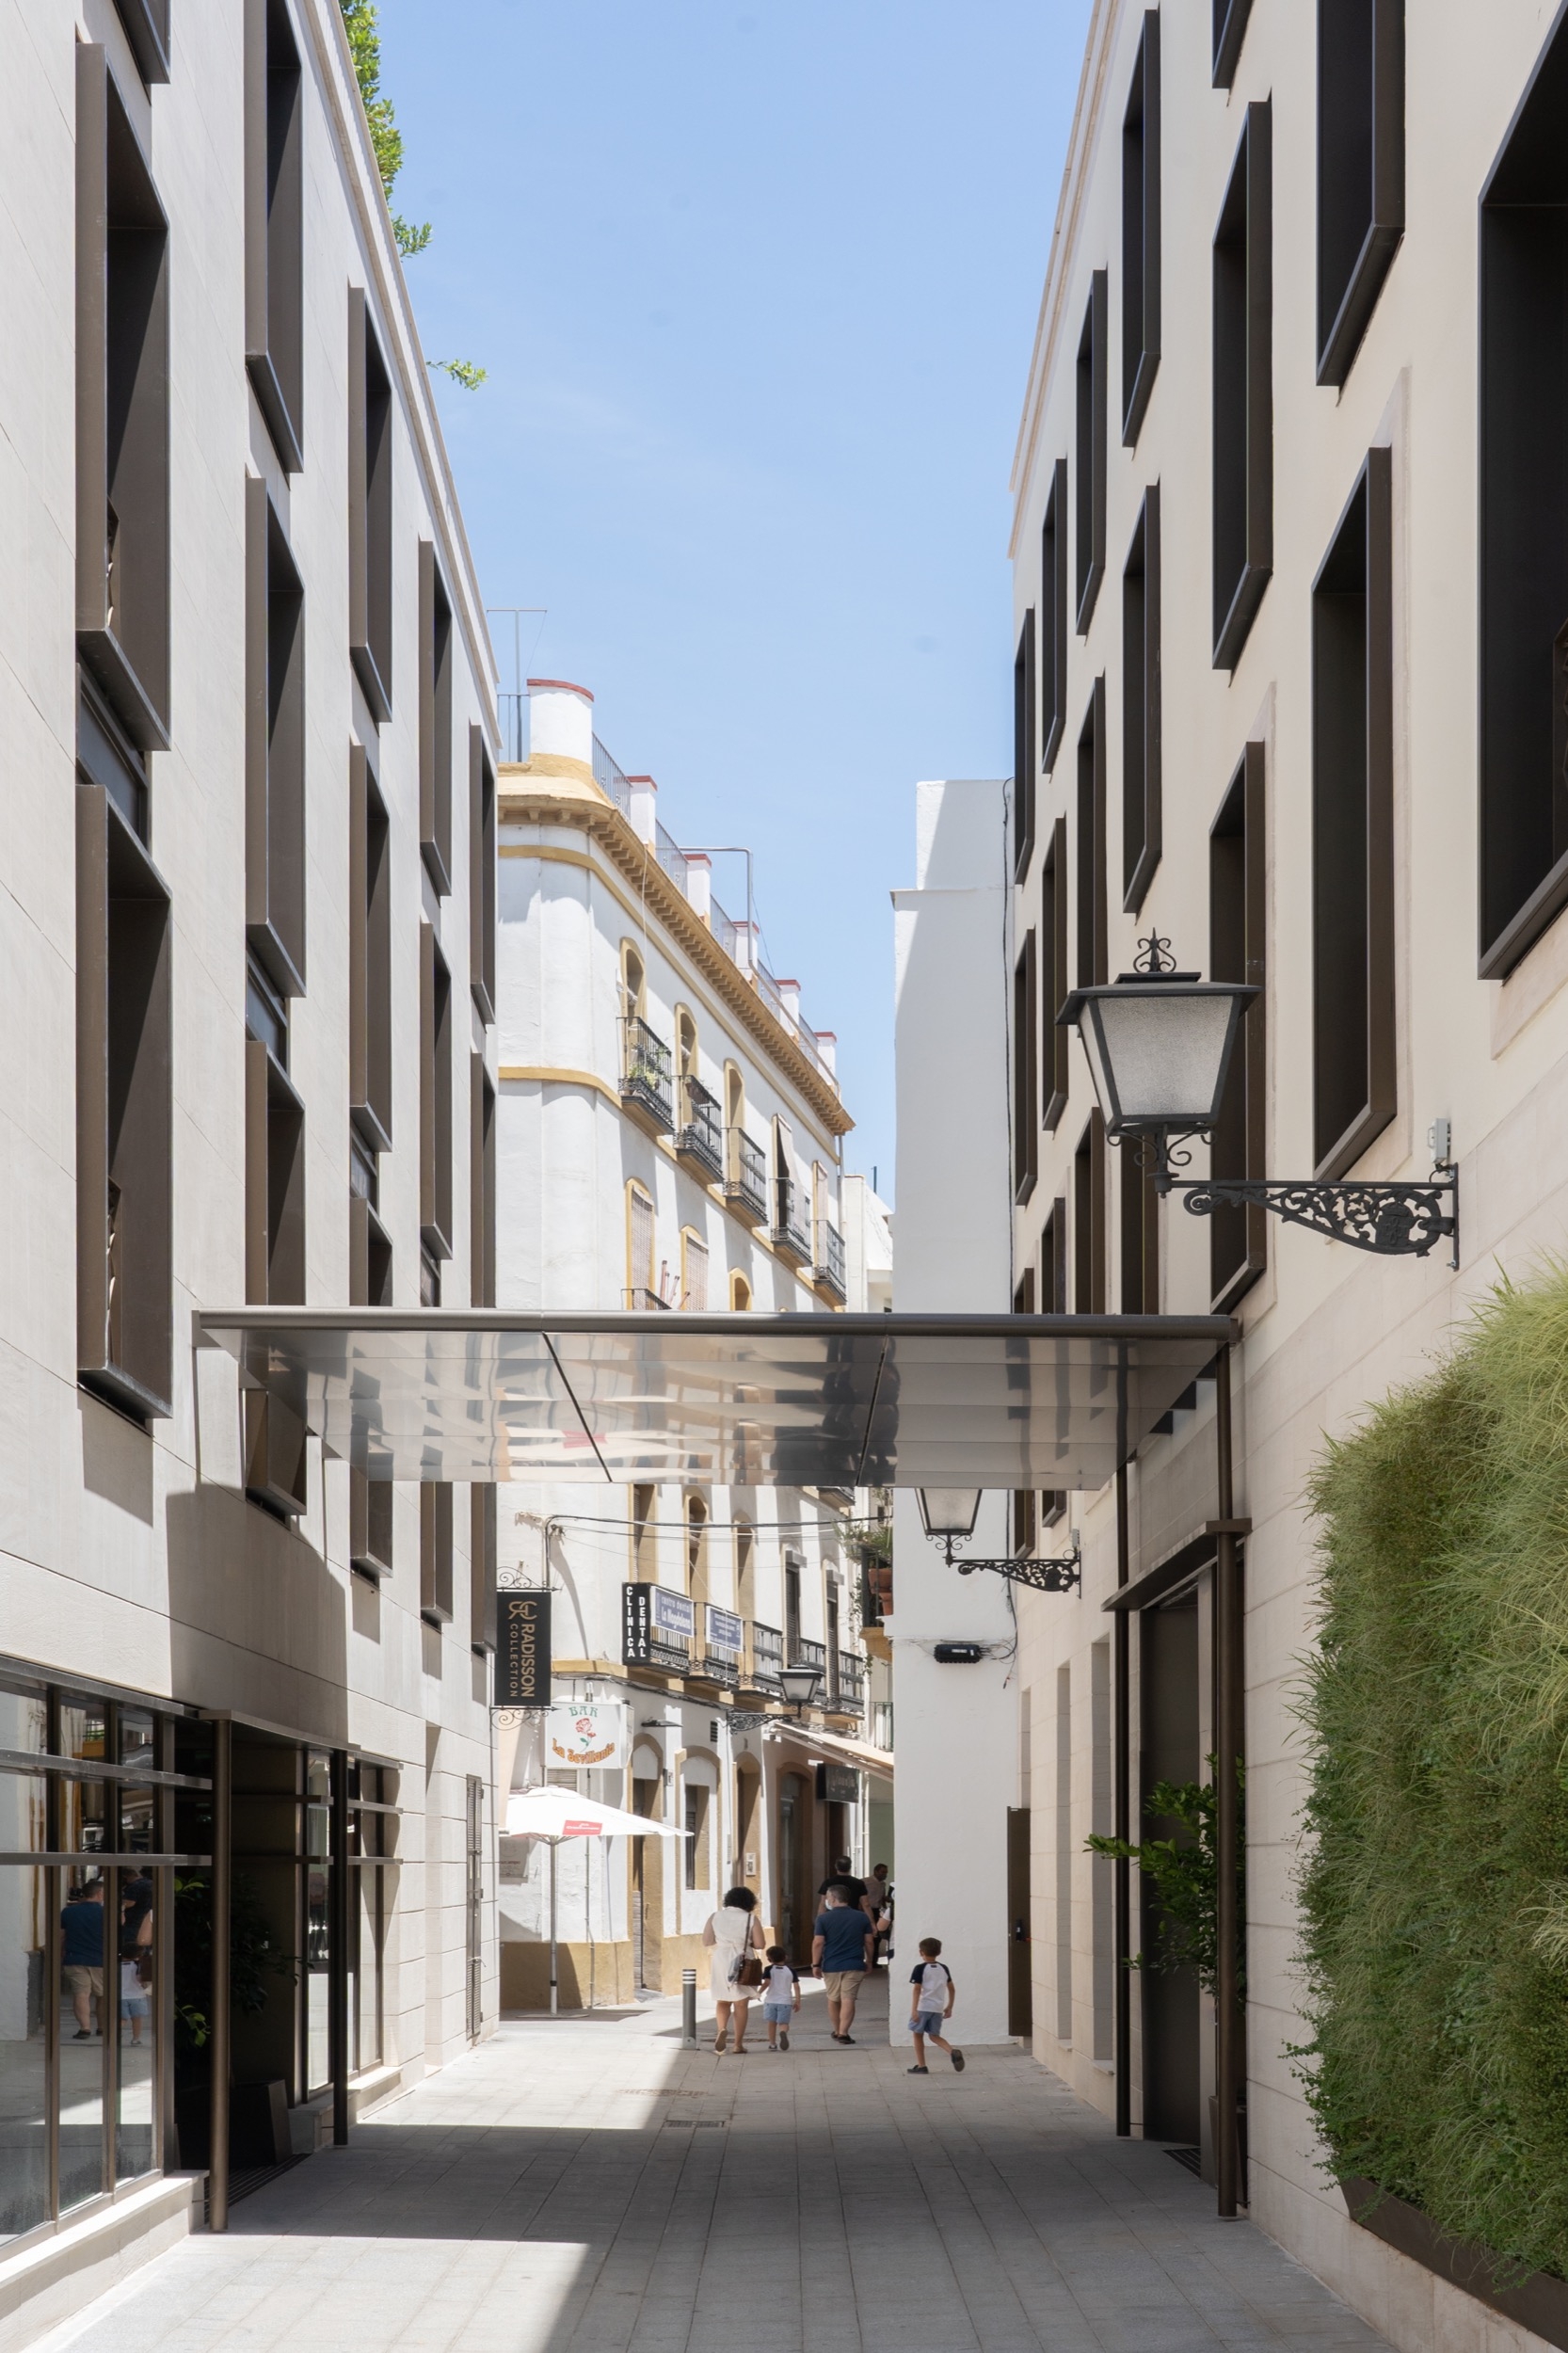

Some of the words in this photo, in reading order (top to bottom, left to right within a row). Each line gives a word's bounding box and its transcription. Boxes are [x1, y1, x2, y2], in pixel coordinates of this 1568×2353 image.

[626, 1586, 635, 1657] CLINICA
[637, 1596, 647, 1657] DENTAL
[510, 1623, 519, 1697] COLLECTION
[520, 1624, 536, 1697] RADISSON
[568, 1705, 599, 1718] BAR
[552, 1737, 565, 1759] La
